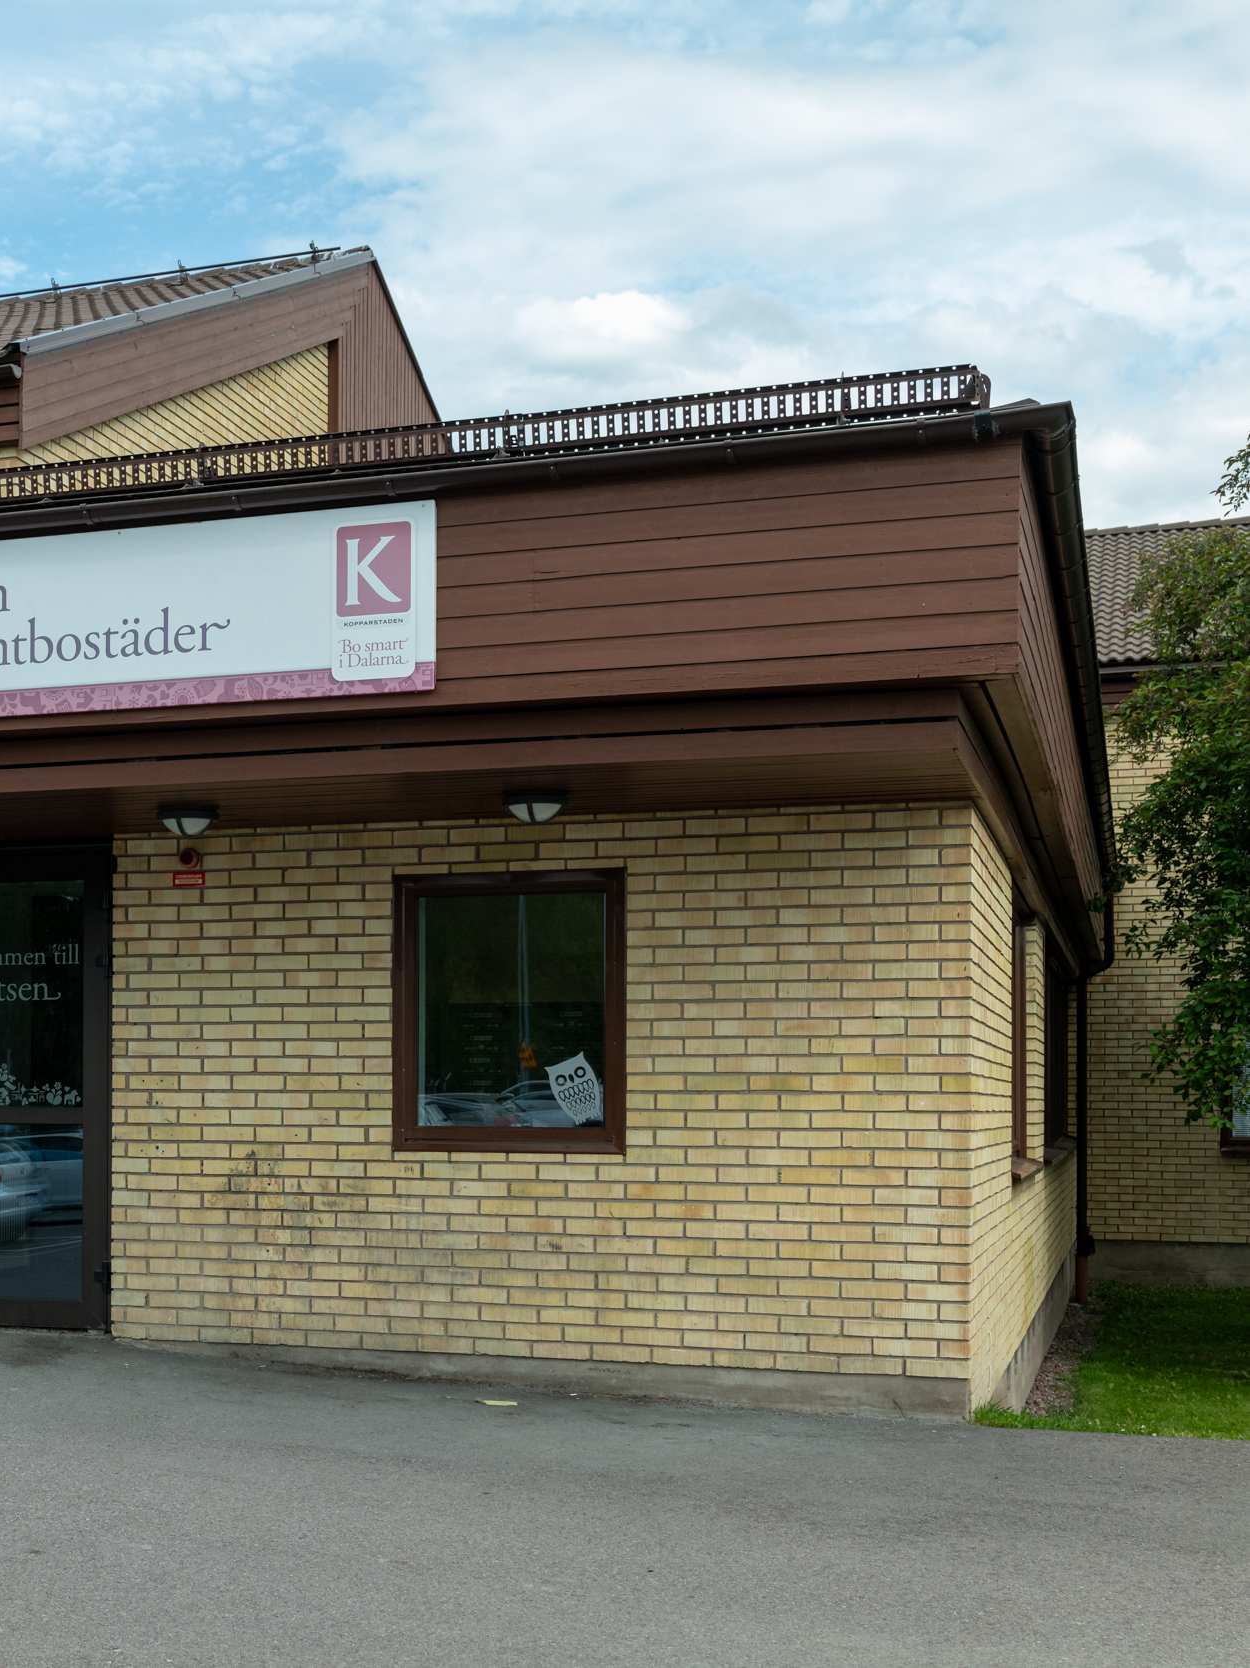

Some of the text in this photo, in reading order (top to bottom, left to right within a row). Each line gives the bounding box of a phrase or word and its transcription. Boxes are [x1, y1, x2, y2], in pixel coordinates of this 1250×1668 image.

[344, 535, 403, 606] K
[343, 618, 404, 628] KOPPARSTADEN
[338, 637, 409, 654] Bo smart
[338, 652, 409, 669] i Dalarna
[54, 943, 80, 965] till
